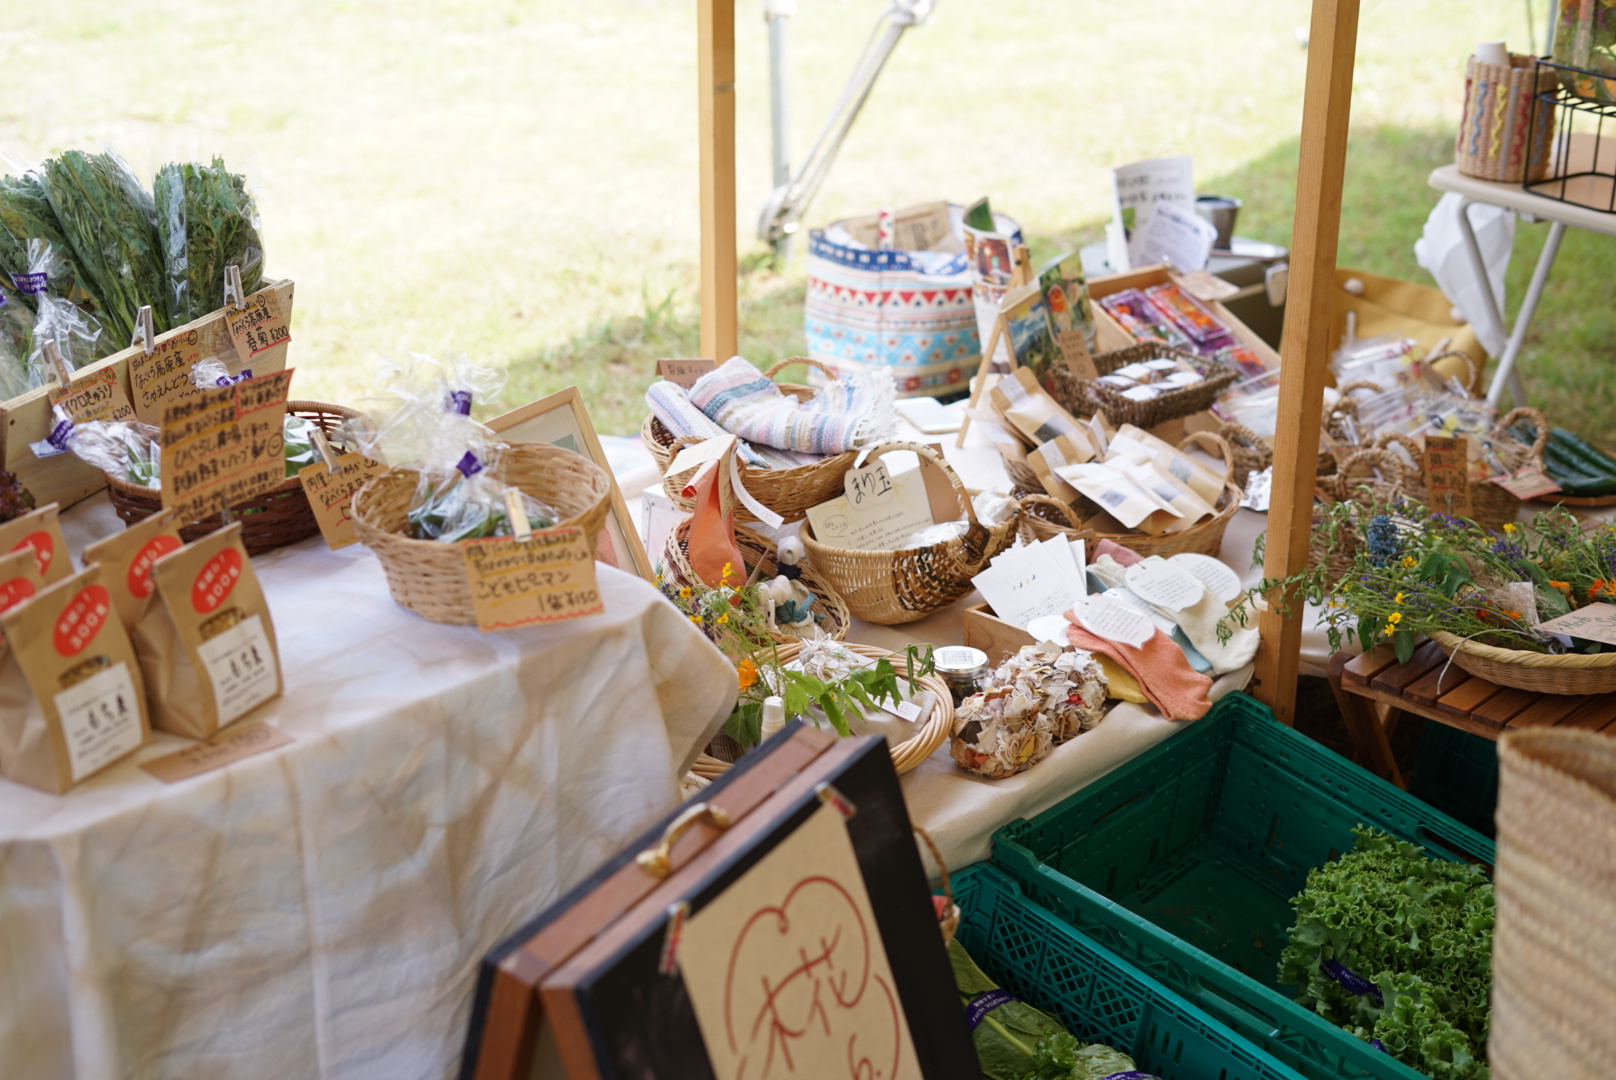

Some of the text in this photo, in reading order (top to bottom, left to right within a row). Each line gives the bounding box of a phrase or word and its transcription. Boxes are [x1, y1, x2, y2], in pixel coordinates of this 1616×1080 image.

[231, 307, 272, 336] なべくら高原産
[246, 325, 289, 351] 春菊 ¥200
[134, 350, 185, 389] なべくら高原産
[143, 372, 189, 408] さやえんどう
[112, 405, 132, 423] ¥200
[851, 465, 893, 504] まゆ玉
[566, 590, 597, 607] ¥150
[971, 1006, 986, 1023] FRESH
